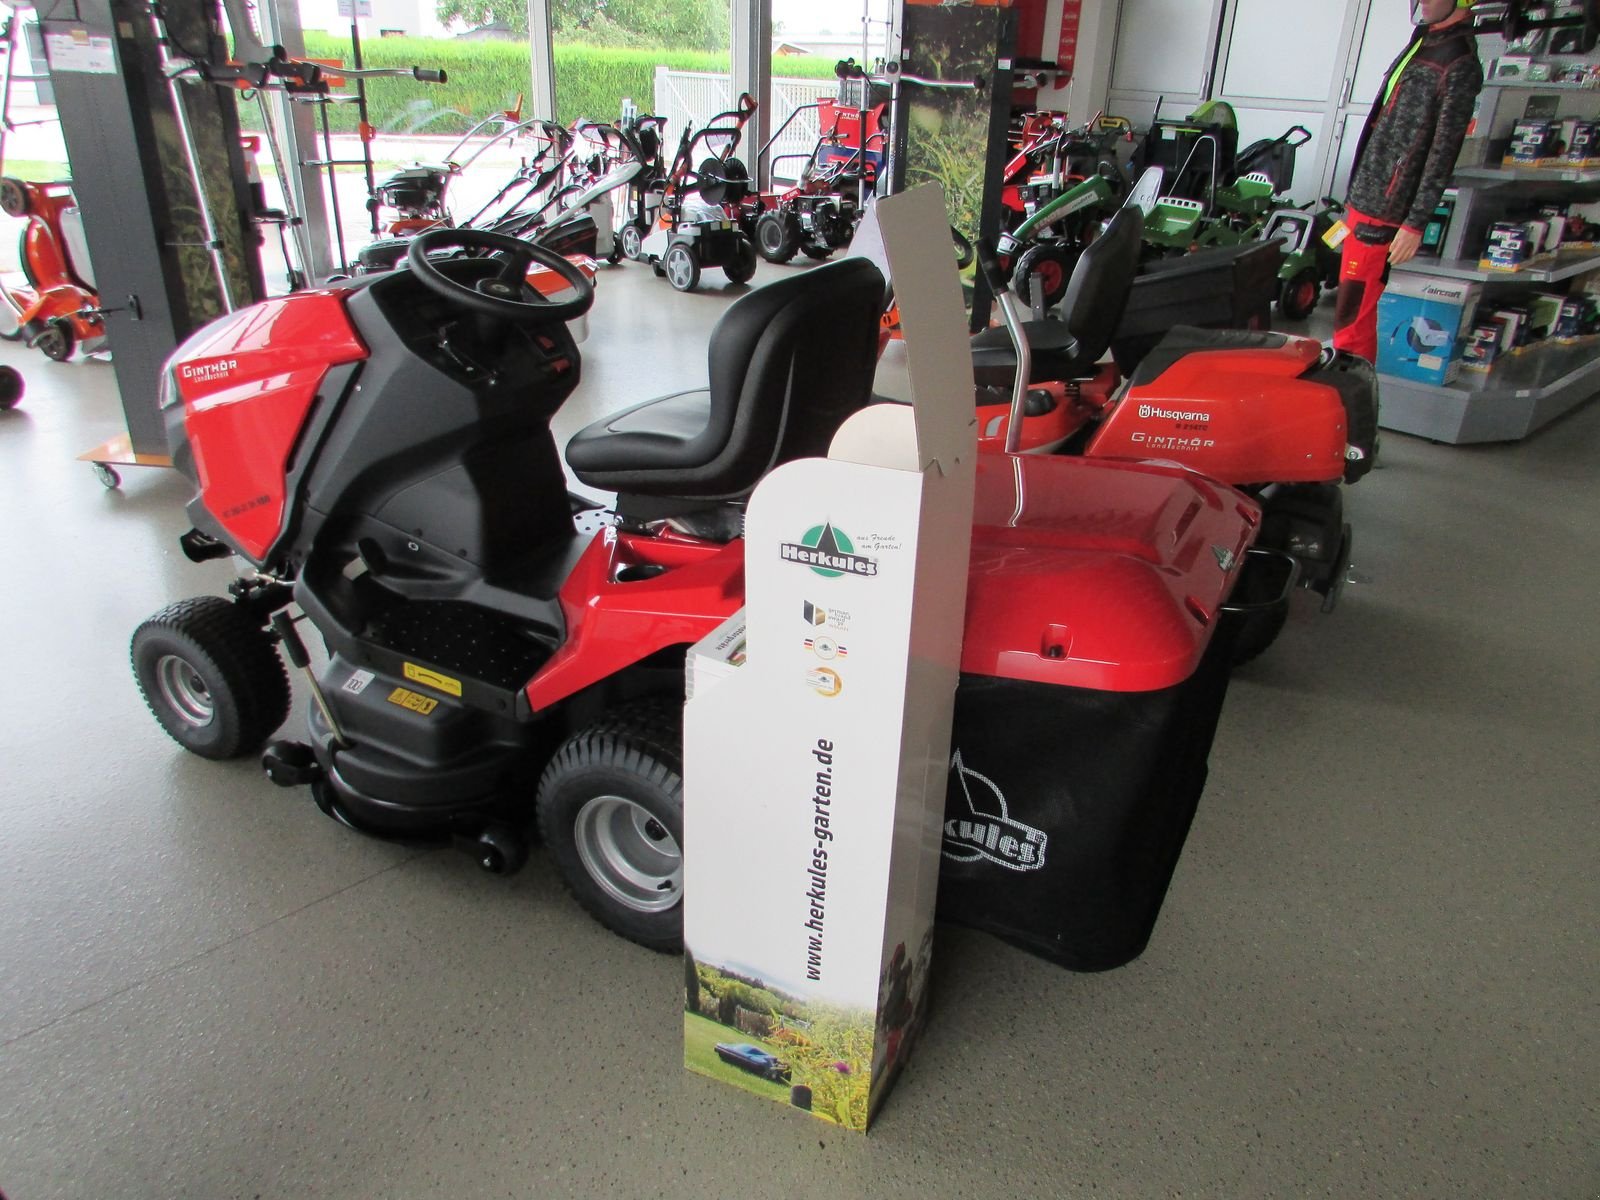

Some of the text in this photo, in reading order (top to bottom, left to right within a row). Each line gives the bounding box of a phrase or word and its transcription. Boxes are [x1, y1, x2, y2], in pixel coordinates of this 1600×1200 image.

[1427, 287, 1462, 299] aircraft
[183, 359, 238, 380] GINTHÖR
[1151, 407, 1210, 422] Husqvarna
[1131, 432, 1215, 449] GINTHÖR
[781, 544, 877, 575] Herkules
[804, 738, 834, 981] www.herkules-garten.de
